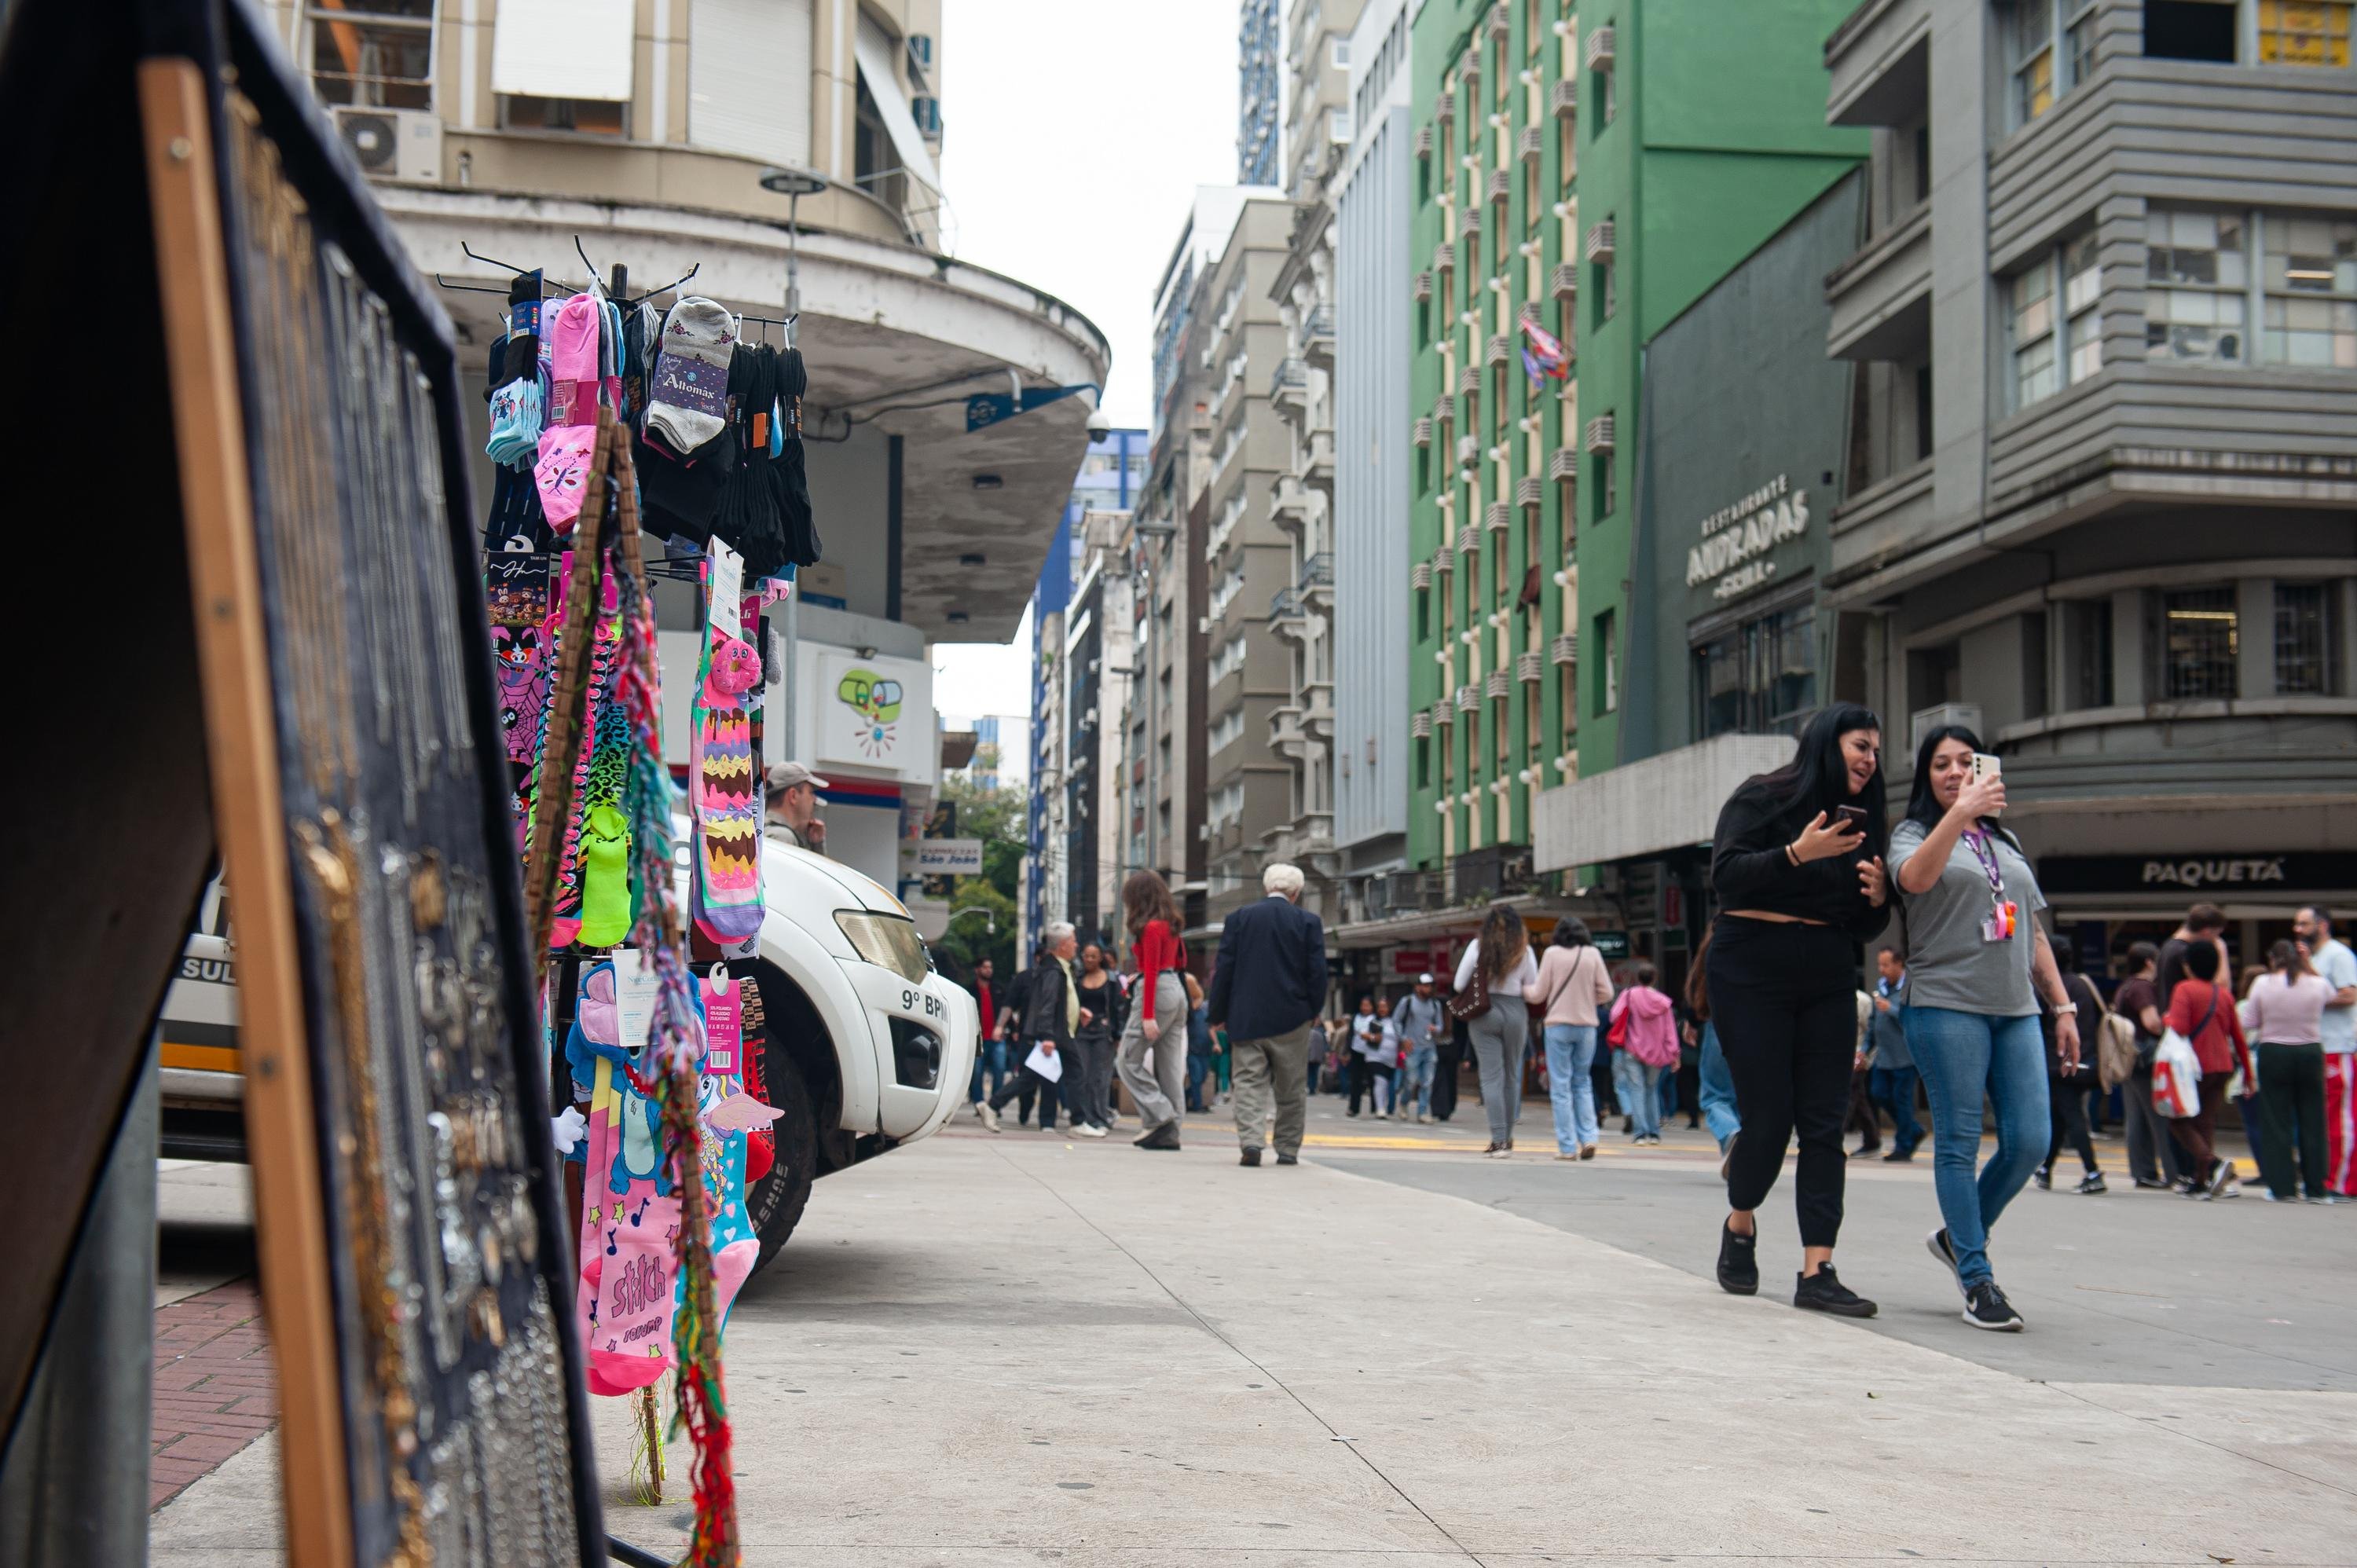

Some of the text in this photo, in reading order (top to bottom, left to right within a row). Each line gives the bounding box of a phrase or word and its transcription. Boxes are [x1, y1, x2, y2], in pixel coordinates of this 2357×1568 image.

[662, 373, 716, 400] Altomax
[1700, 473, 1788, 537] RESTAURANTE
[1685, 489, 1809, 588] ANDRADAS
[2143, 858, 2285, 887] PAQUETÁ
[181, 958, 236, 984] SUL
